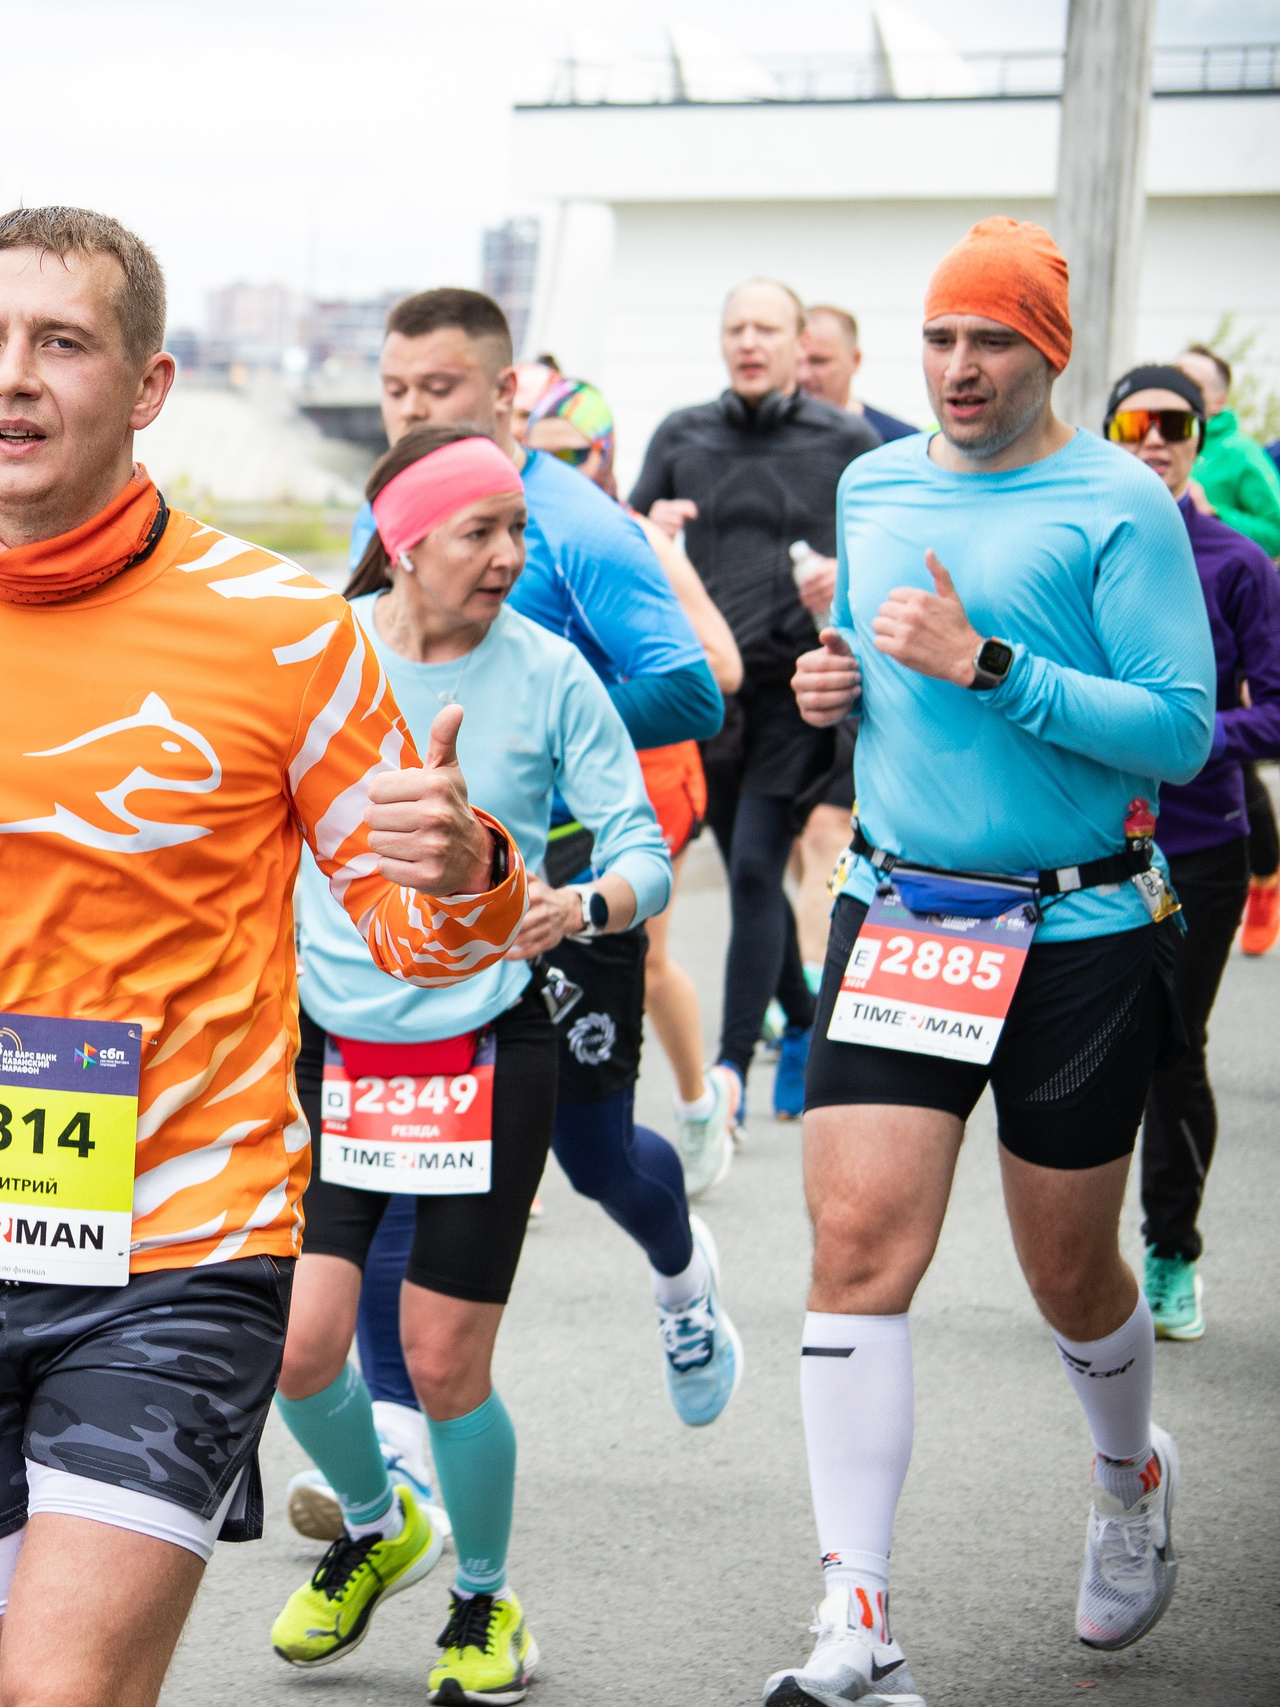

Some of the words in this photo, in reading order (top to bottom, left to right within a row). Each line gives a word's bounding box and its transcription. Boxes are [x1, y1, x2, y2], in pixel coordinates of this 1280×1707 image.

[853, 949, 870, 968] E
[880, 936, 1005, 990] 2885
[844, 977, 866, 989] 2024
[2, 1057, 50, 1068] КАЗАНСКИЙ
[2, 1064, 39, 1075] МАРАФОН
[354, 1074, 478, 1115] 2349
[391, 1124, 440, 1139] РЕЗЕДА
